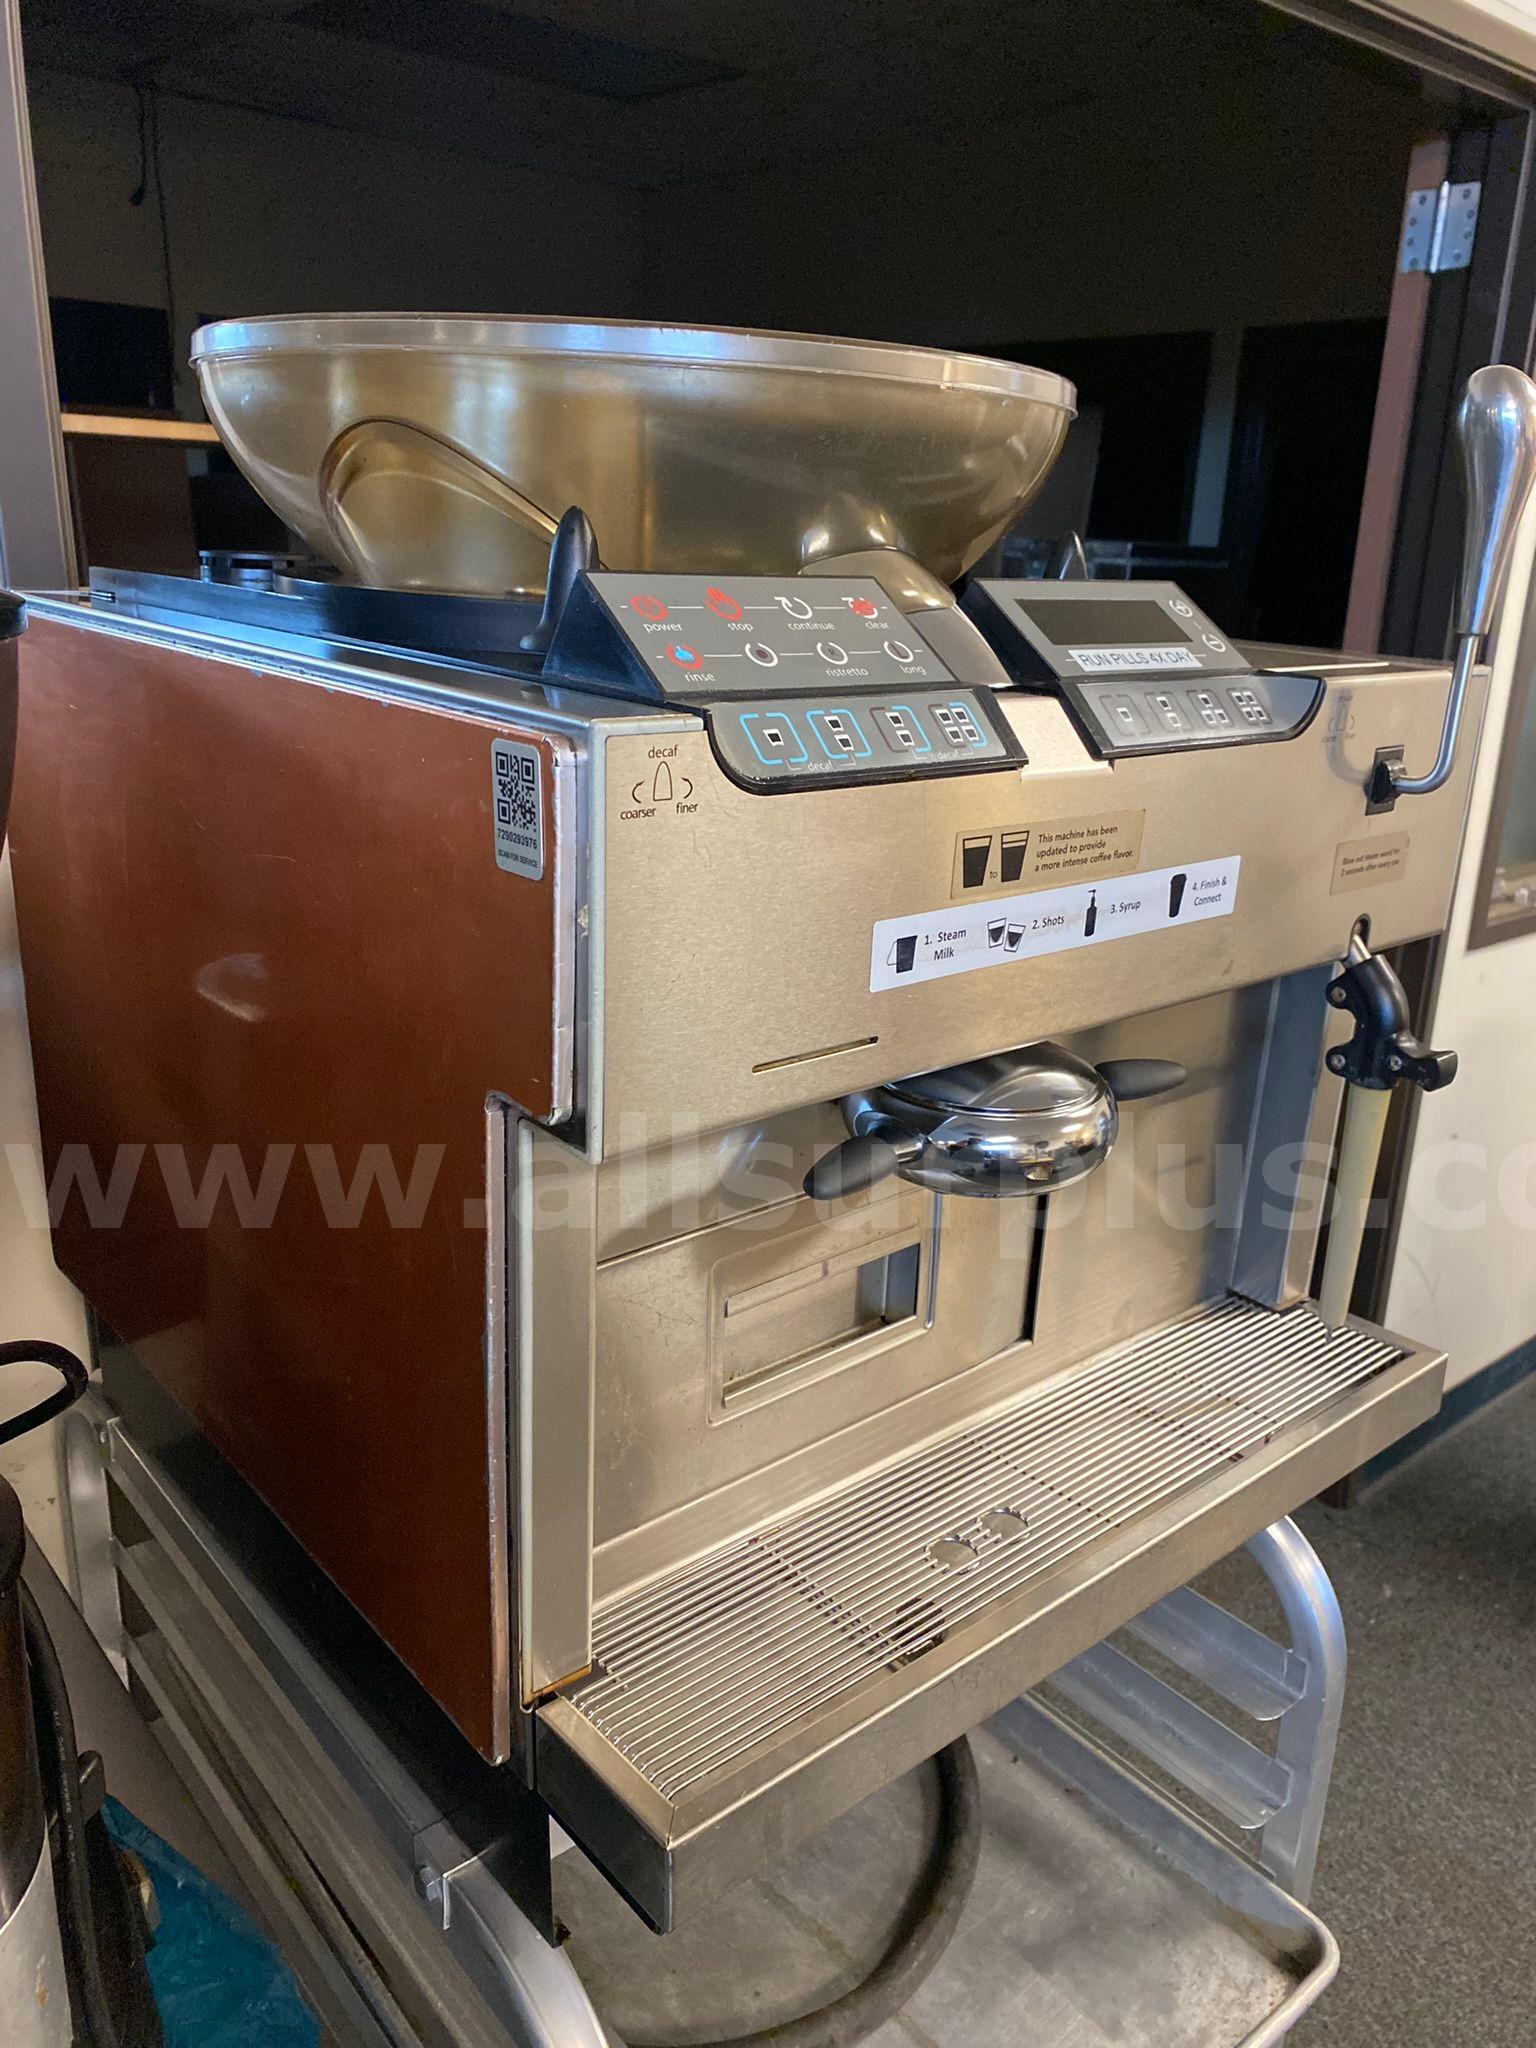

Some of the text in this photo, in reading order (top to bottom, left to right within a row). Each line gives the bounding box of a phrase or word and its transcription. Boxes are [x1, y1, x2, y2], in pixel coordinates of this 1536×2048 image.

[643, 622, 683, 634] power
[728, 622, 753, 634] stop
[788, 621, 835, 631] continue
[865, 620, 889, 630] clear
[1078, 654, 1111, 666] RUN
[1110, 653, 1149, 665] PILLS
[1165, 651, 1193, 663] DAY
[826, 667, 868, 677] ristretto
[899, 664, 926, 676] long
[685, 672, 715, 682] rinse
[648, 744, 678, 758] decaf
[620, 807, 656, 820] coarser
[676, 802, 698, 814] finer
[1038, 826, 1118, 844] This machine has been
[1036, 839, 1106, 859] updated to provide
[1034, 864, 1039, 872] a
[1041, 861, 1060, 871] more
[1062, 857, 1088, 868] intense
[1090, 852, 1111, 864] coffee
[990, 871, 997, 879] to
[1200, 878, 1220, 889] Finish
[1221, 876, 1227, 886] &
[1194, 893, 1222, 906] Connect
[1110, 900, 1141, 914] 3. Syrup
[1032, 915, 1065, 930] 2. Shots
[924, 930, 967, 945] 1. Steam
[933, 947, 955, 961] Milk
